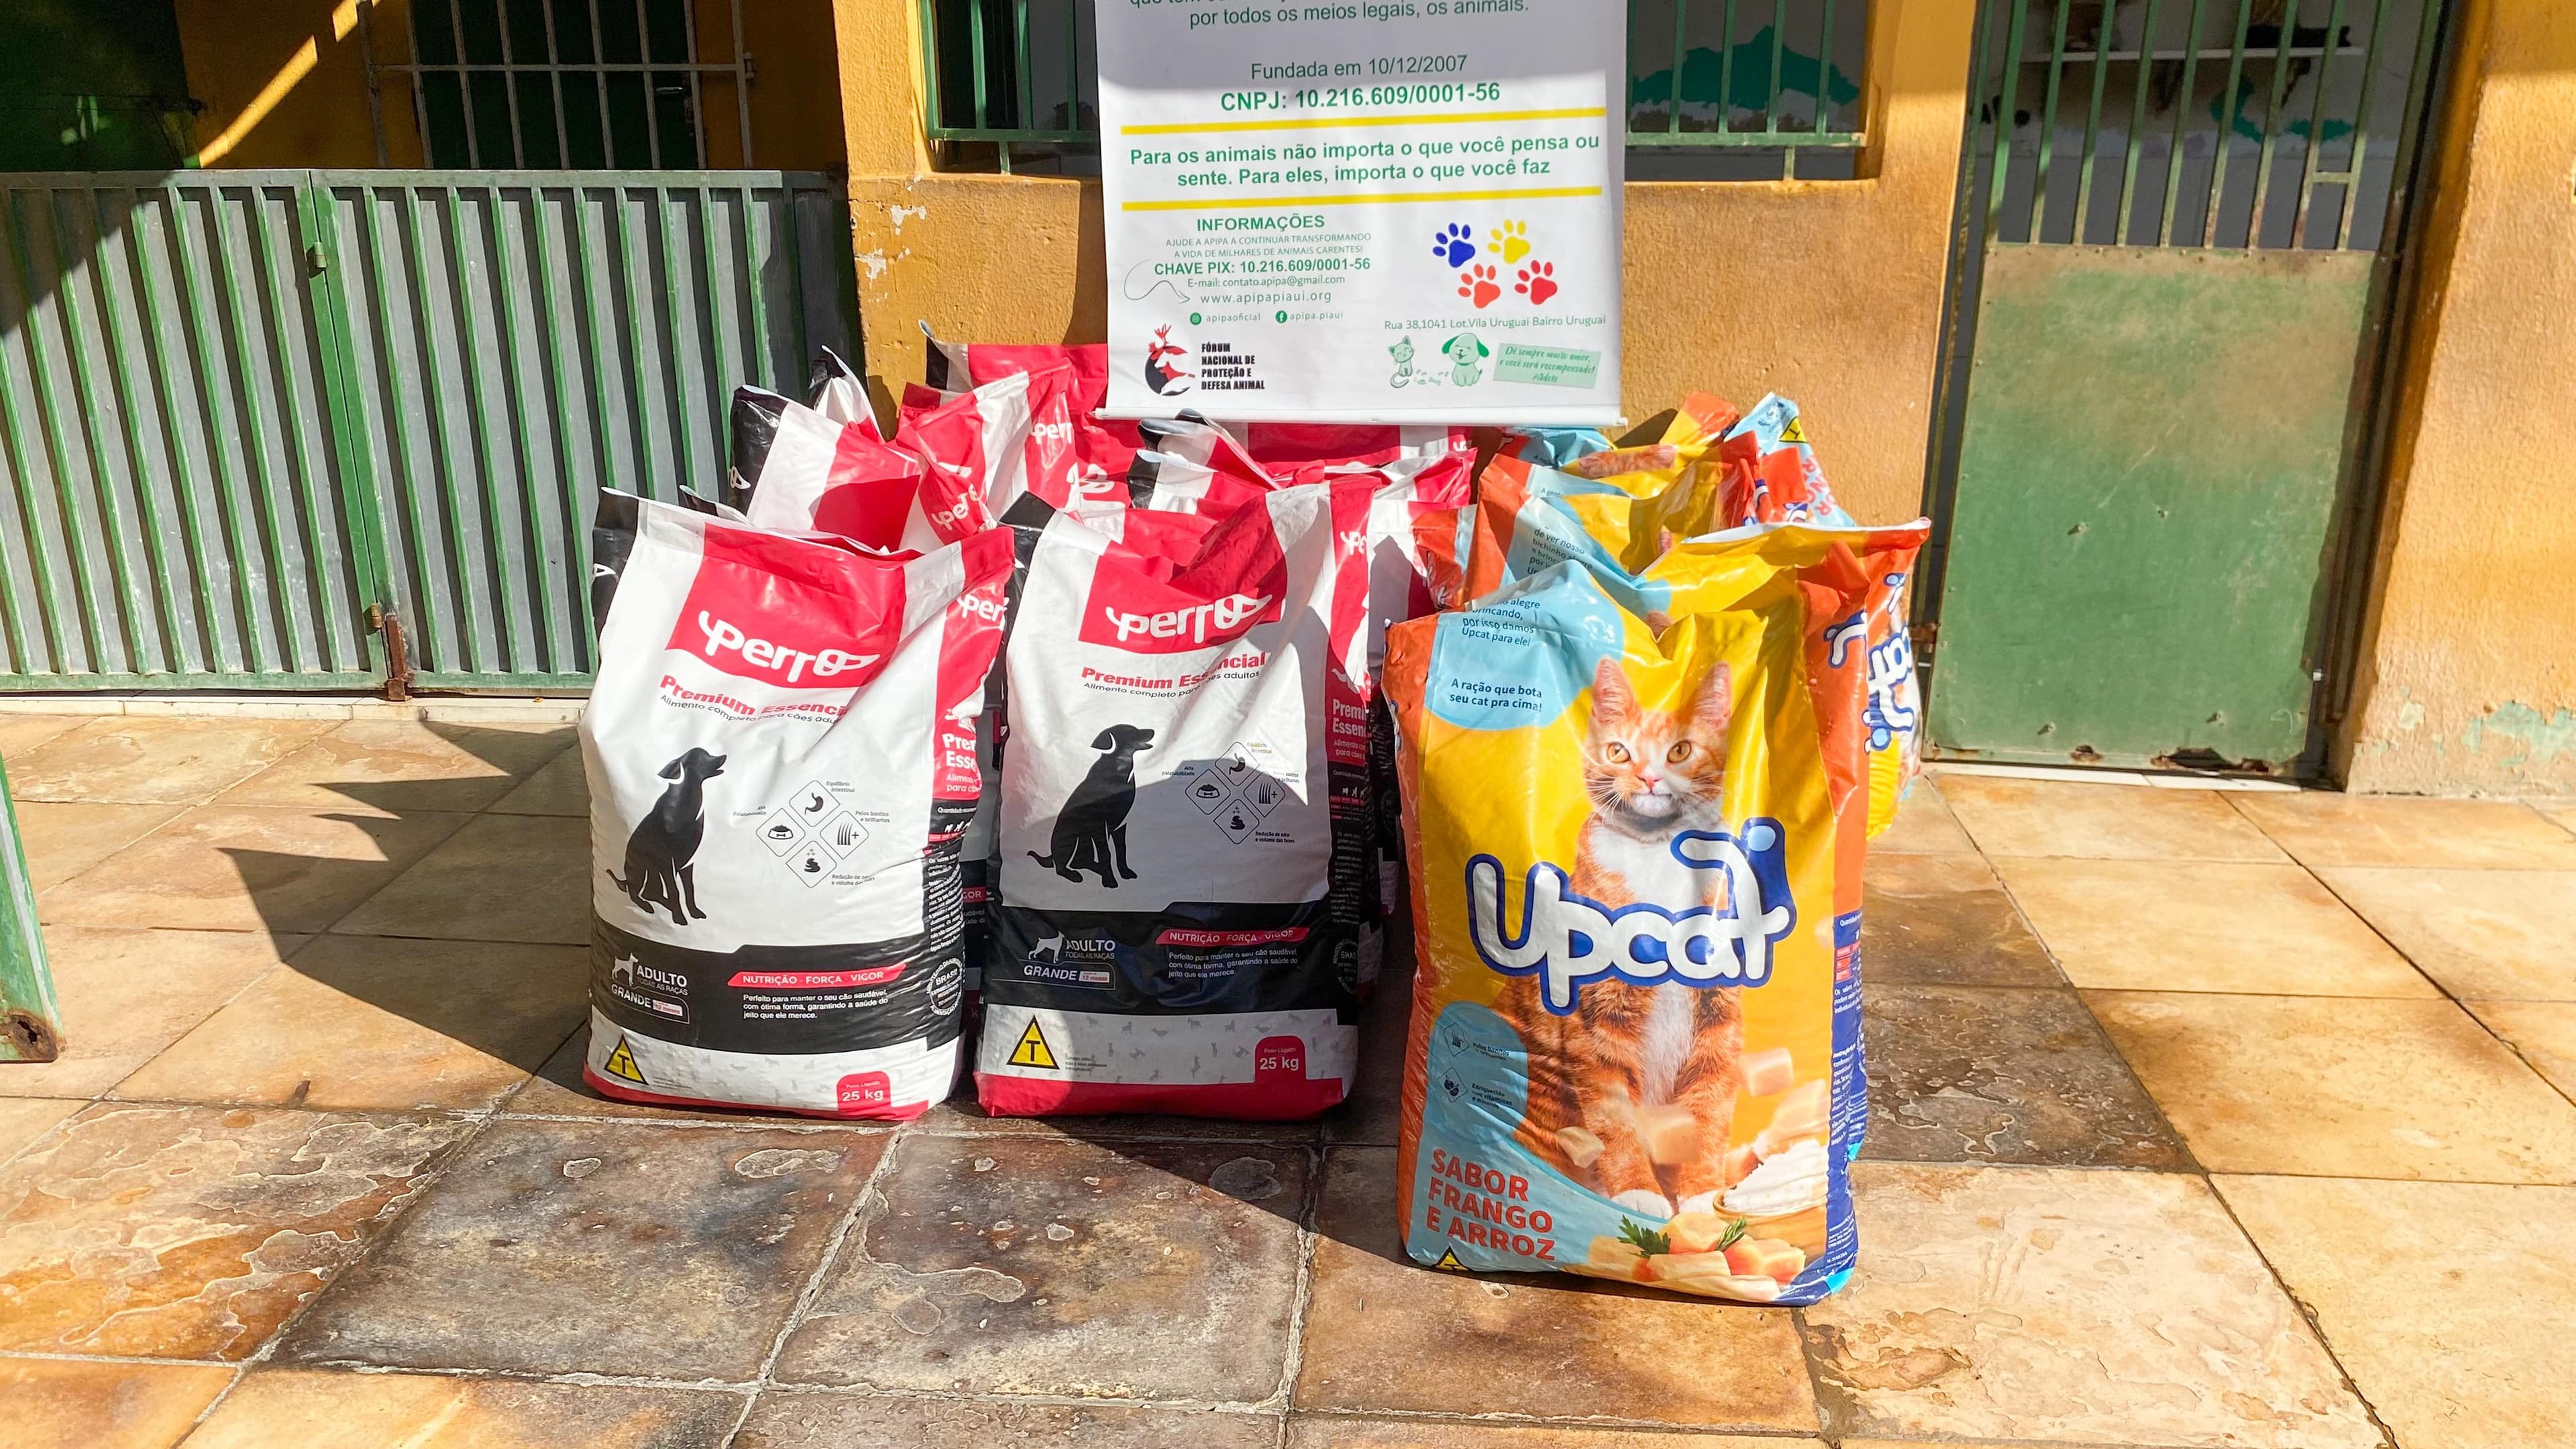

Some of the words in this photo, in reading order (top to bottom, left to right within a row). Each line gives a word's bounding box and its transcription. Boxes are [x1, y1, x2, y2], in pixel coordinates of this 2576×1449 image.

[1190, 13, 1218, 30] por
[1224, 7, 1271, 23] todos
[1277, 9, 1297, 21] os
[1304, 3, 1356, 21] meios
[1363, 1, 1420, 21] legais,
[1427, 3, 1448, 15] os
[1454, 0, 1529, 13] animais.
[1251, 61, 1328, 79] Fundada
[1334, 64, 1361, 76] em
[1369, 55, 1467, 74] 10/12/2007
[1221, 91, 1287, 111] CNPJ:
[1295, 82, 1500, 107] 10.216.609/0001-56
[1130, 149, 1171, 165] Para
[1178, 150, 1199, 163] os
[1205, 145, 1277, 162] animais
[1283, 143, 1316, 160] não
[1323, 141, 1394, 161] importa
[1401, 143, 1412, 156] o
[1419, 142, 1453, 158] que
[1460, 136, 1505, 153] você
[1511, 138, 1568, 155] pensa
[1576, 136, 1599, 148] ou
[1177, 170, 1232, 186] sente.
[1239, 168, 1279, 184] Para
[1286, 167, 1328, 184] eles,
[1335, 164, 1406, 184] importa
[1413, 166, 1424, 178] o
[1430, 164, 1464, 181] que
[1471, 160, 1515, 176] você
[1523, 158, 1550, 174] faz
[1197, 213, 1325, 231] INFORMAÇÕES
[1166, 238, 1193, 246] AJUDE
[1204, 237, 1228, 246] APIPA
[1239, 235, 1289, 245] CONTINUAR
[1292, 233, 1371, 243] TRANSFORMANDO
[1182, 250, 1202, 258] VIDA
[1219, 248, 1261, 258] MILHARES
[1263, 248, 1275, 256] DE
[1277, 246, 1313, 256] ANIMAIS
[1316, 245, 1362, 254] CARENTES!
[1155, 262, 1203, 275] CHAVE
[1208, 261, 1234, 274] PIX:
[1240, 258, 1371, 273] 10.216.609/0001-56
[1188, 277, 1220, 287] E-mail:
[1223, 274, 1345, 288] contato.apipa@gmail.com
[1201, 290, 1332, 305] www.apipapiaui.org
[1207, 312, 1260, 324] apipaoficial
[1290, 311, 1344, 321] apipa.piaui
[1385, 321, 1403, 330] Rua
[1406, 319, 1446, 330] 38,1041
[1490, 318, 1529, 329] Uruguai
[1532, 317, 1563, 327] Bairro
[1566, 315, 1607, 327] Uruguai
[1201, 341, 1230, 353] FÓRUM
[1519, 348, 1544, 359] sempre
[1201, 355, 1243, 365] NACIONAL
[1244, 355, 1255, 364] DE
[1201, 366, 1245, 379] PROTEÇÃO
[1246, 368, 1252, 377] E
[1201, 380, 1231, 390] DEFESA
[1233, 380, 1265, 390] ANIMAL
[1462, 617, 1479, 628] por
[1502, 621, 1534, 633] damos
[1462, 627, 1490, 639] Upcat
[1491, 633, 1513, 643] para
[1514, 637, 1531, 647] ele!
[1081, 667, 1173, 689] Premium
[1084, 682, 1127, 694] Alimento
[1130, 689, 1176, 698] completo
[1224, 670, 1260, 680] adultos
[660, 674, 756, 715] Premium
[1451, 678, 1458, 688] A
[1461, 682, 1492, 694] ração
[1494, 686, 1515, 696] que
[1517, 685, 1542, 698] bota
[660, 694, 706, 710] Alimento
[708, 706, 757, 722] completo
[757, 712, 785, 720] para
[787, 712, 812, 722] cães
[1450, 694, 1468, 704] seu
[1471, 697, 1491, 706] cat
[1491, 700, 1509, 708] pra
[1512, 698, 1542, 712] cima!
[1467, 818, 1795, 1014] Upcat
[1170, 932, 1220, 945] NUTRIÇÃO
[1227, 934, 1258, 943] FORÇA
[1264, 929, 1293, 940] VIGOR
[1066, 939, 1116, 952] ADULTO
[1093, 953, 1116, 961] RAÇAS
[1169, 951, 1193, 961] Perfeito
[637, 965, 688, 987] ADULTO
[743, 975, 798, 986] NUTRIÇÃO
[806, 975, 843, 985] FORÇA
[851, 971, 884, 981] VIGOR
[1024, 965, 1077, 981] GRANDE
[611, 984, 651, 1008] GRANDE
[657, 983, 665, 991] AS
[665, 985, 688, 996] RAÇAS
[743, 994, 771, 1003] Perfeito
[760, 1002, 782, 1010] ótima
[782, 1002, 806, 1011] forma,
[808, 1002, 846, 1012] garantindo
[855, 999, 877, 1008] saúde
[743, 1011, 759, 1020] jeito
[1025, 1040, 1040, 1062] T
[617, 1053, 630, 1074] T
[1259, 1057, 1277, 1070] 25
[1281, 1056, 1299, 1071] kg
[841, 1090, 860, 1102] 25
[864, 1089, 883, 1102] kg
[1483, 1092, 1513, 1106] vitaminas
[1431, 1148, 1529, 1202] SABOR
[1428, 1176, 1553, 1233] FRANGO
[1427, 1205, 1442, 1233] E
[1446, 1216, 1556, 1261] ARROZ
